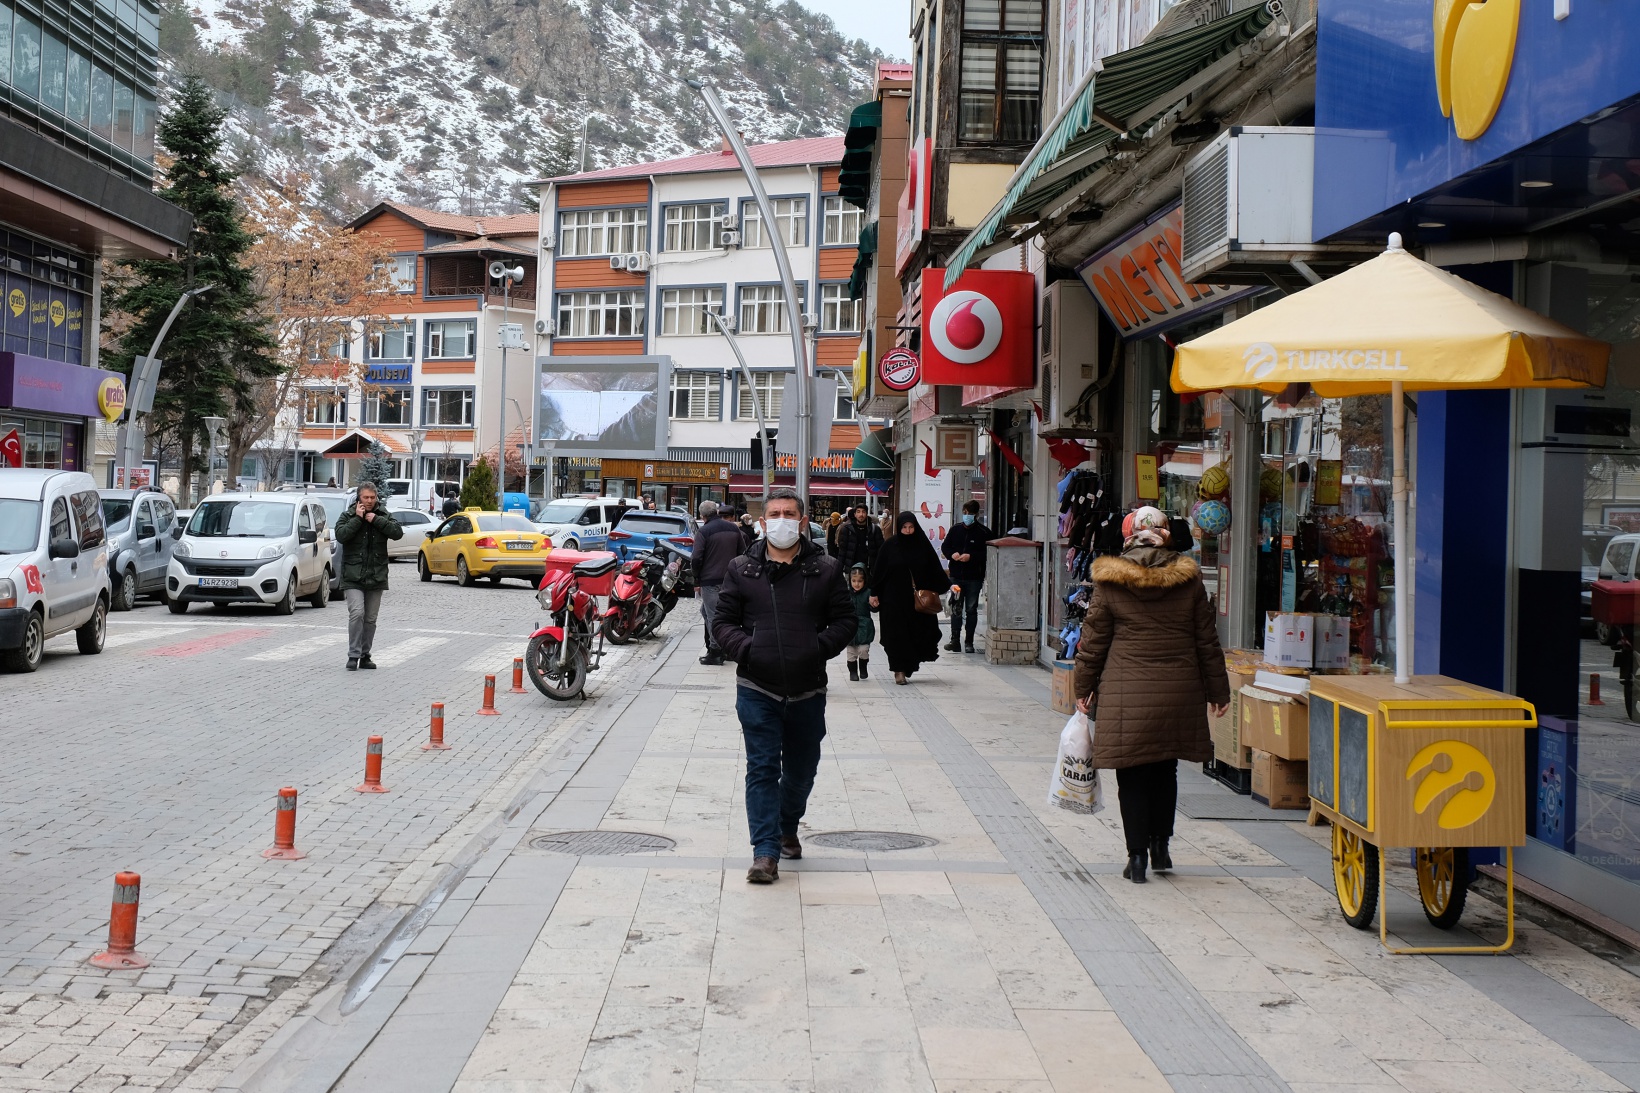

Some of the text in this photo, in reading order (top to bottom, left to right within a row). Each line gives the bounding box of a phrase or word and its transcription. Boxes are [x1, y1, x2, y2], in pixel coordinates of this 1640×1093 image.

[11, 293, 24, 307] gratis
[52, 305, 64, 317] gratis
[1285, 349, 1408, 370] TURKCELL
[106, 384, 124, 407] gratis
[945, 434, 966, 459] E
[584, 527, 600, 536] POLİS
[1594, 750, 1619, 758] ATIK
